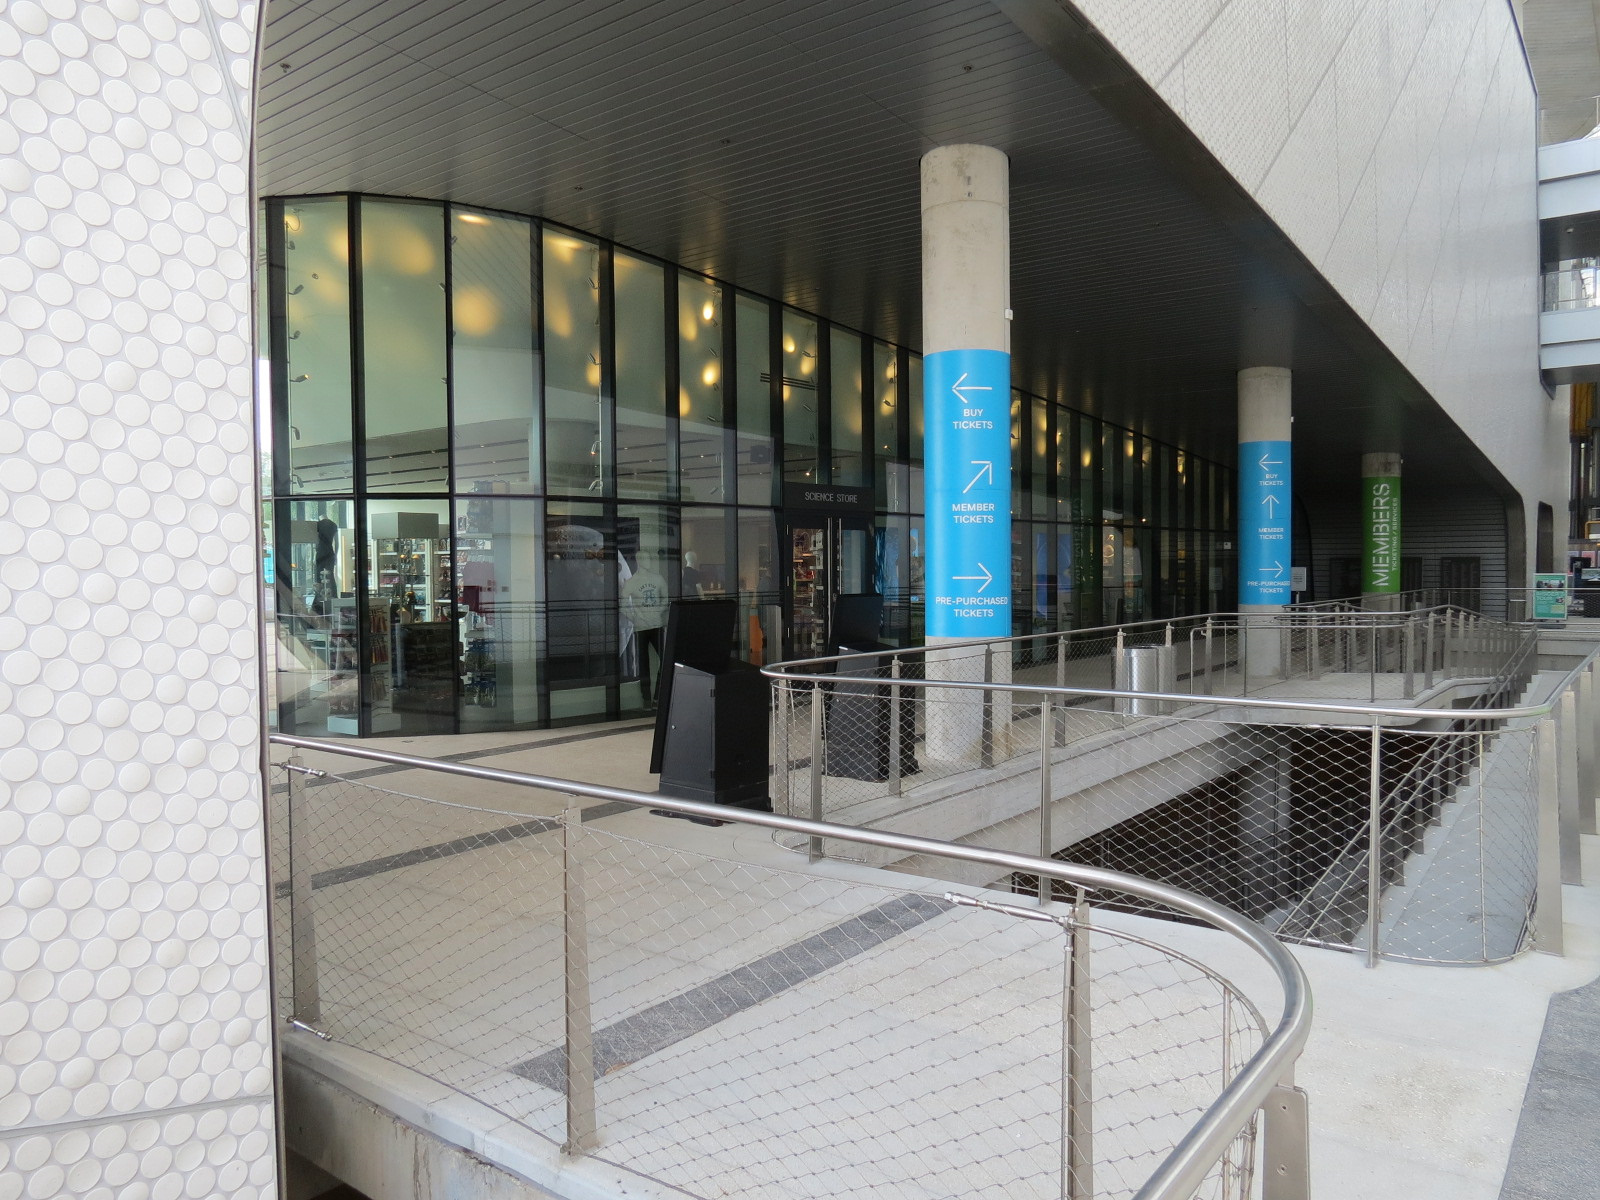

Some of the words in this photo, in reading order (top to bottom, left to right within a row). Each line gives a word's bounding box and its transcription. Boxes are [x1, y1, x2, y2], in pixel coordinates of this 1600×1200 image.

[963, 408, 984, 417] BUY
[953, 420, 993, 430] TICKETS
[804, 491, 834, 502] SCIENCE
[836, 493, 858, 504] STORE
[952, 503, 995, 512] MEMBER
[954, 514, 994, 524] TICKETS
[1372, 483, 1390, 587] MEMBERS
[935, 596, 1008, 606] PRE-PURCHASED
[954, 608, 994, 618] TICKETS
